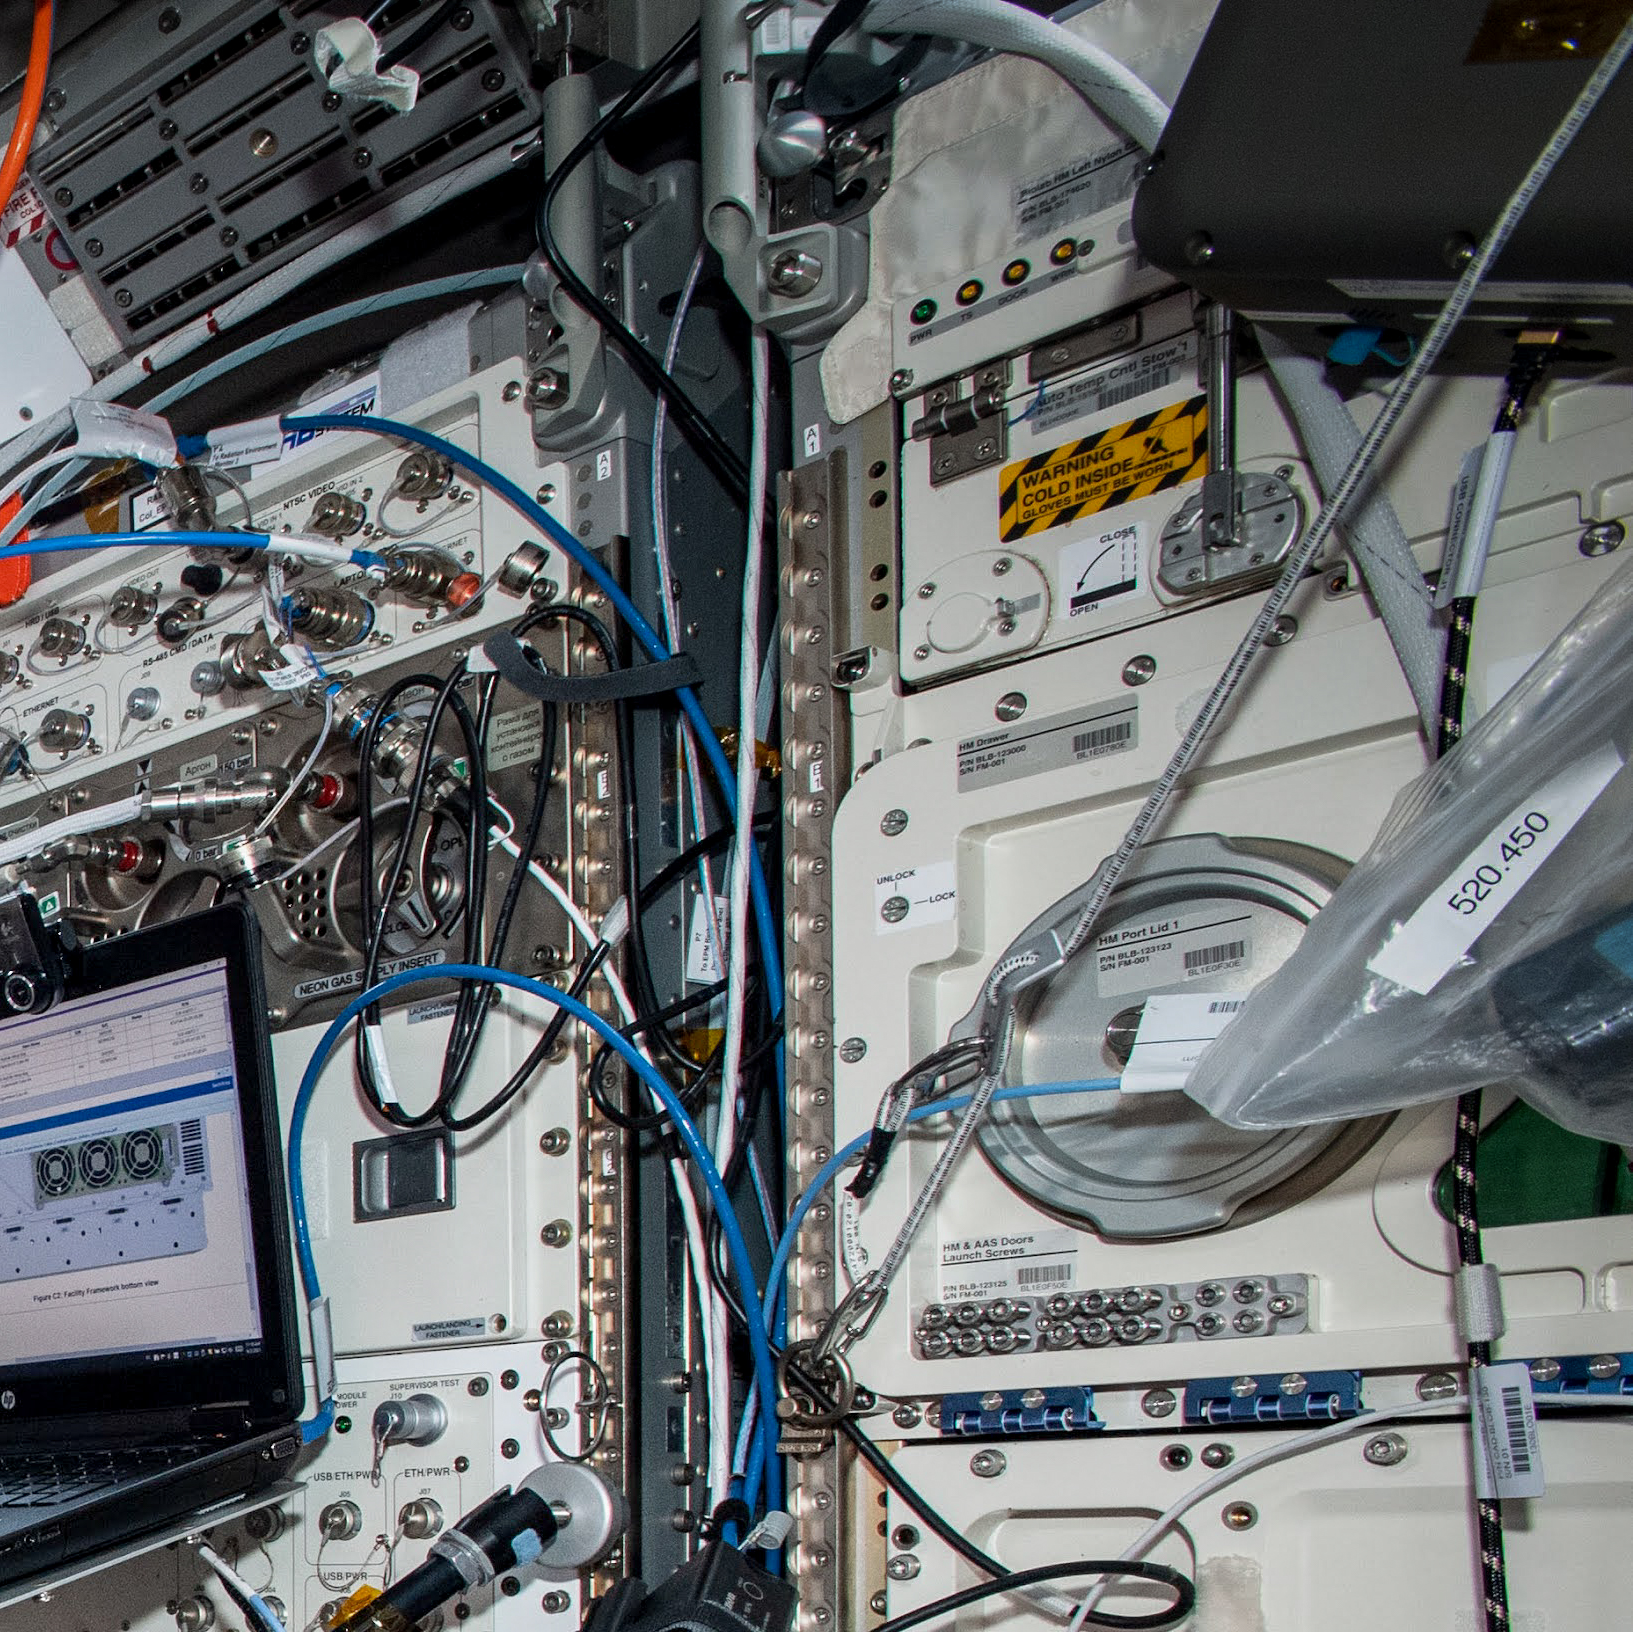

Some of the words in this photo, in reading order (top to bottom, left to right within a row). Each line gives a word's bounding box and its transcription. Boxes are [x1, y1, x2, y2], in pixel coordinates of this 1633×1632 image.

[909, 327, 933, 344] PWR
[1068, 376, 1104, 399] Temp
[1022, 446, 1115, 488] WARNING
[1022, 496, 1070, 520] GLOVES
[1075, 487, 1106, 504] MUST
[1113, 479, 1129, 490] BE
[1134, 461, 1174, 483] WORN
[1023, 481, 1069, 506] COLD
[1076, 458, 1133, 491] INSIDE
[283, 496, 305, 511] NTSC
[308, 481, 335, 502] VIDEO
[1100, 525, 1136, 543] CLOSE
[1070, 603, 1099, 617] OPEN
[23, 696, 59, 717] ETHERNET
[959, 740, 974, 751] HM
[976, 733, 1009, 746] Drawer
[959, 759, 973, 768] P/N
[959, 767, 974, 776] S/N
[976, 759, 1005, 772] FM-001
[1448, 811, 1549, 914] 520.450
[877, 870, 915, 885] UNLOCK
[929, 890, 956, 904] LOCK
[1098, 935, 1118, 946] HM
[1122, 927, 1146, 941] Port
[1150, 922, 1169, 935] Lid
[1099, 955, 1115, 965] P/N
[1118, 942, 1172, 959] BLB-123123
[1100, 962, 1115, 972] S/N
[1118, 956, 1149, 969] FM-001
[299, 981, 328, 996] NEON
[331, 975, 352, 987] GAS
[398, 953, 438, 972] INSERT
[943, 1243, 960, 1252] HM
[974, 1238, 997, 1248] AAS
[1001, 1235, 1033, 1245] Doors
[943, 1251, 981, 1262] Launch
[985, 1246, 1025, 1257] Screws
[33, 1294, 51, 1303] Figure
[64, 1289, 85, 1299] Facility
[86, 1285, 119, 1296] Framework
[121, 1282, 143, 1291] bottom
[144, 1279, 159, 1288] view
[426, 1330, 461, 1339] FASTENER
[389, 1381, 438, 1392] SUPERVISOR
[337, 1392, 366, 1400] MODULE
